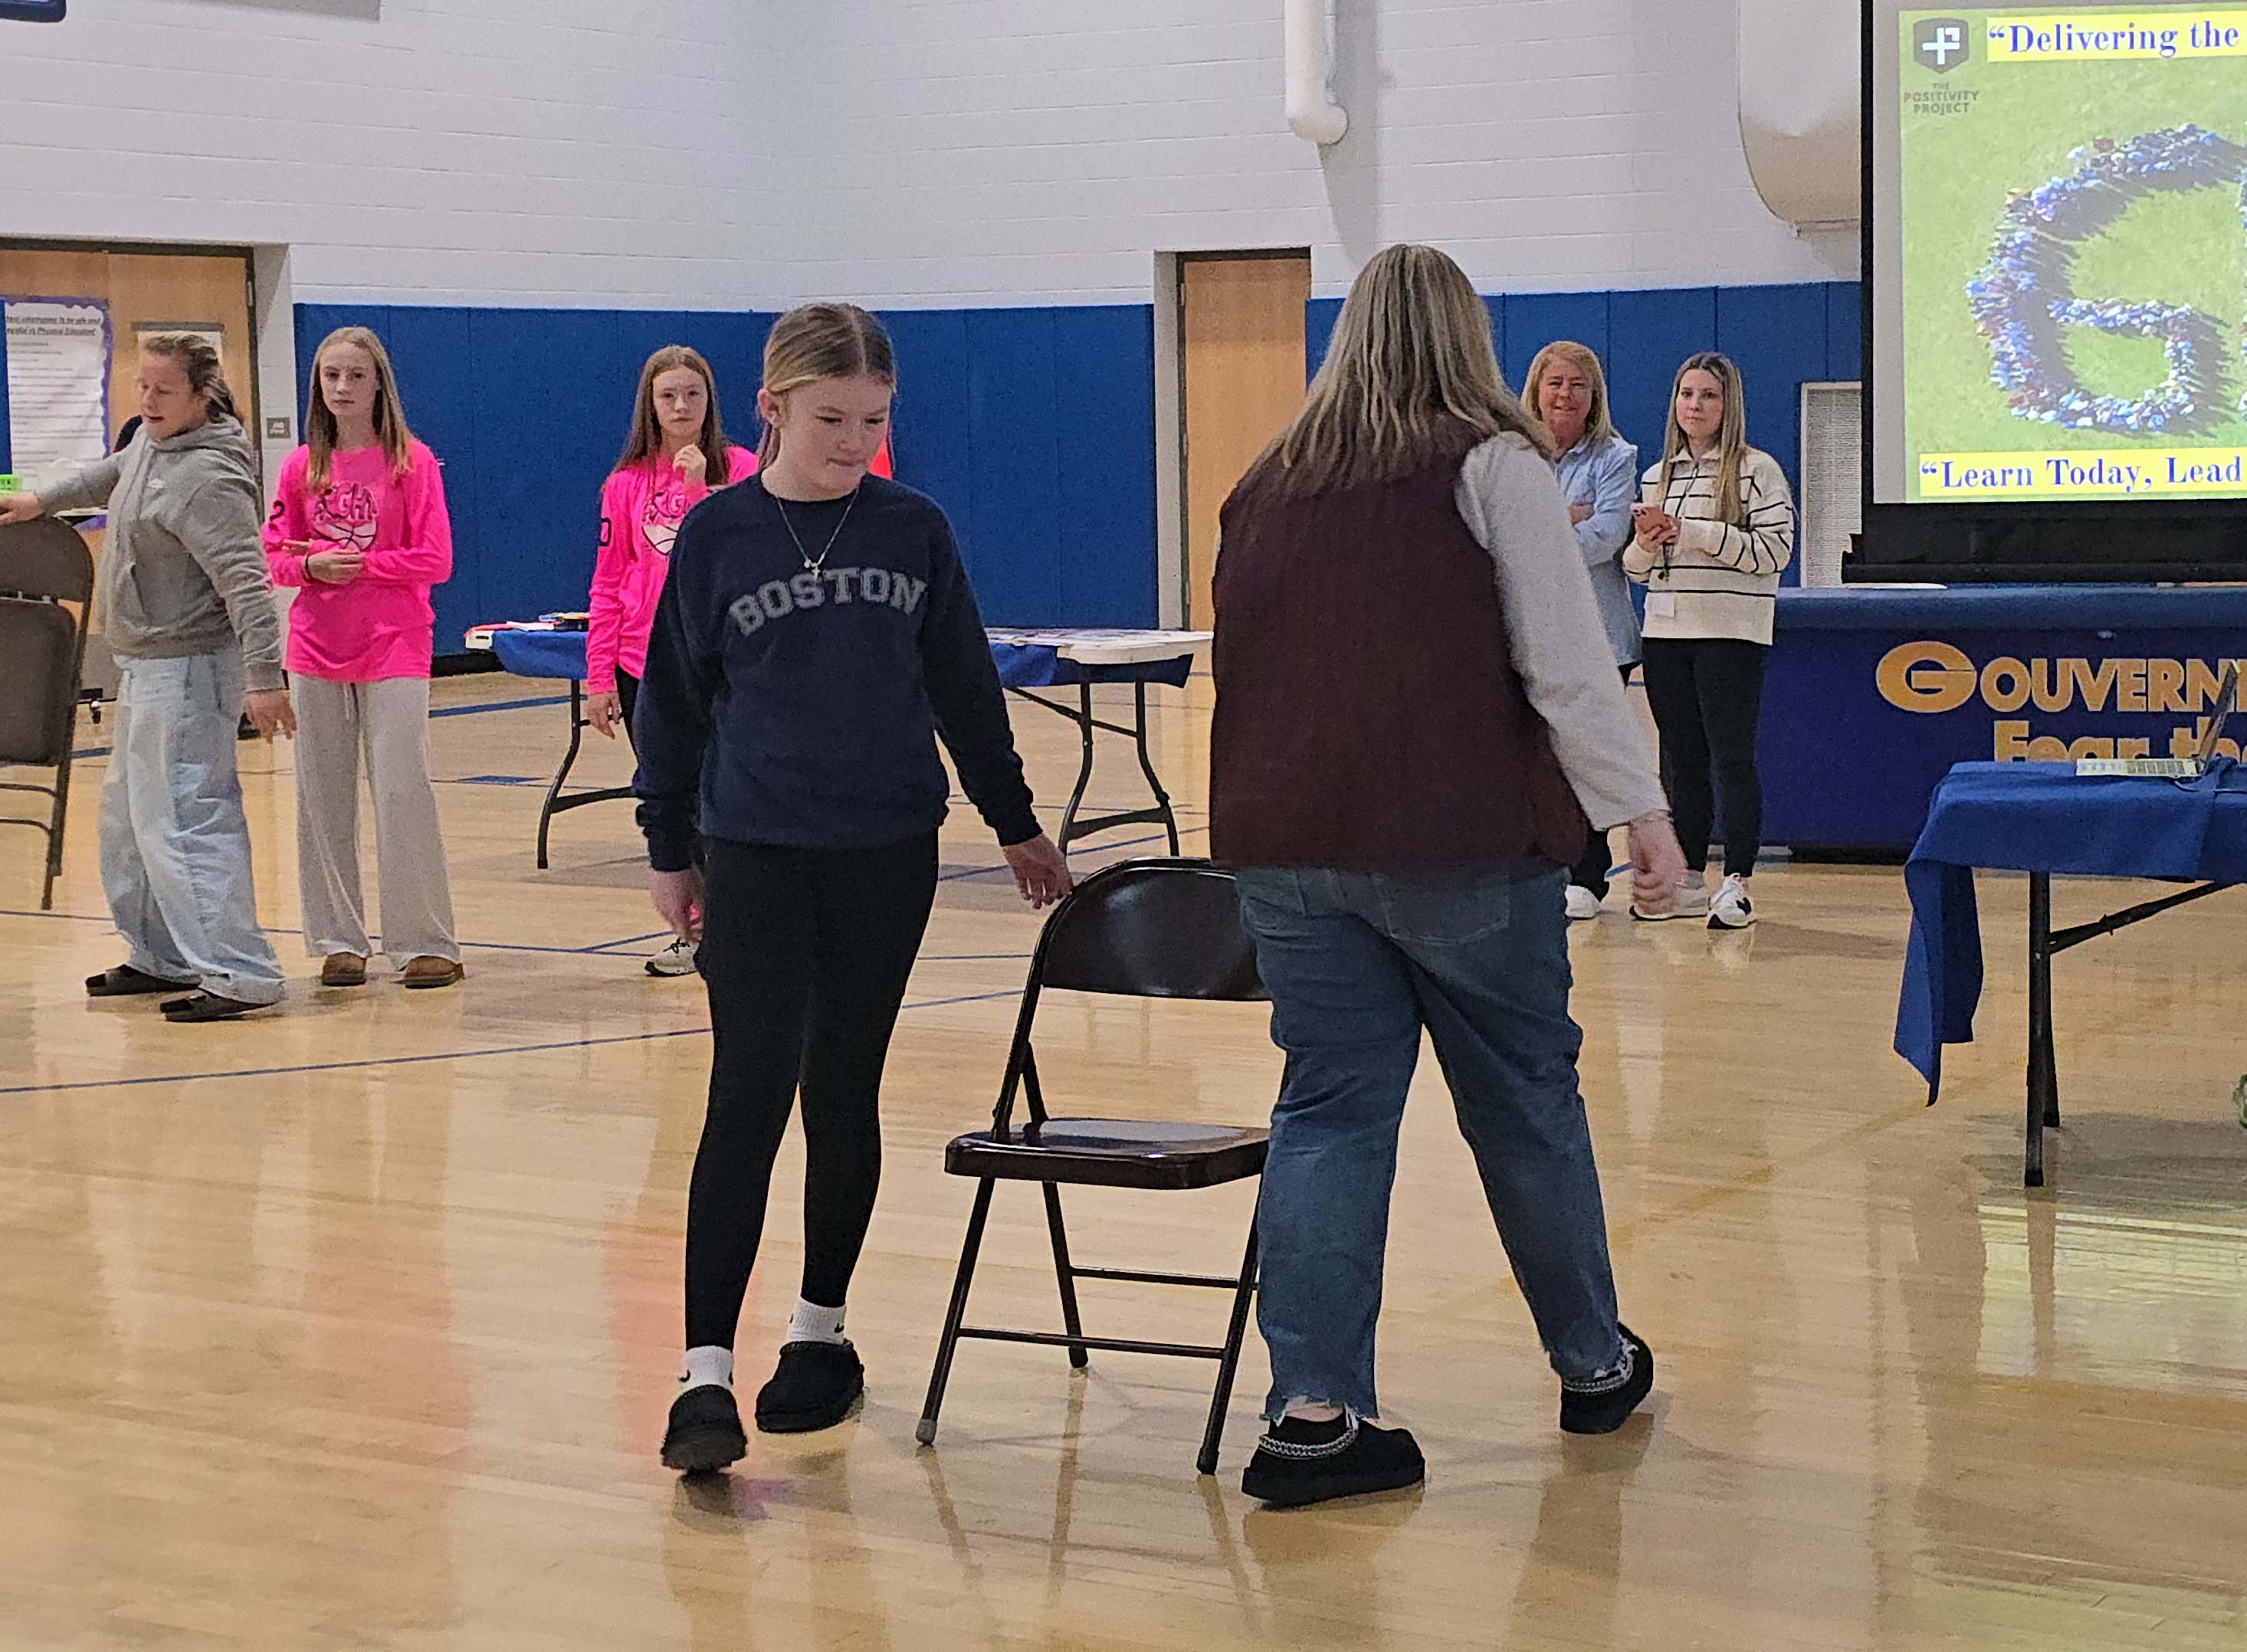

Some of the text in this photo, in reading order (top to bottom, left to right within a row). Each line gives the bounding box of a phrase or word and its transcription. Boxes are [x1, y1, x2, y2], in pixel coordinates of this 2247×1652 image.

[1988, 21, 2239, 59] “Delivering the
[1903, 90, 1981, 103] POSITIVITY
[1913, 102, 1971, 116] PROJECT
[1921, 455, 2242, 493] “Learn Today, Lead
[729, 567, 927, 637] BOSTON
